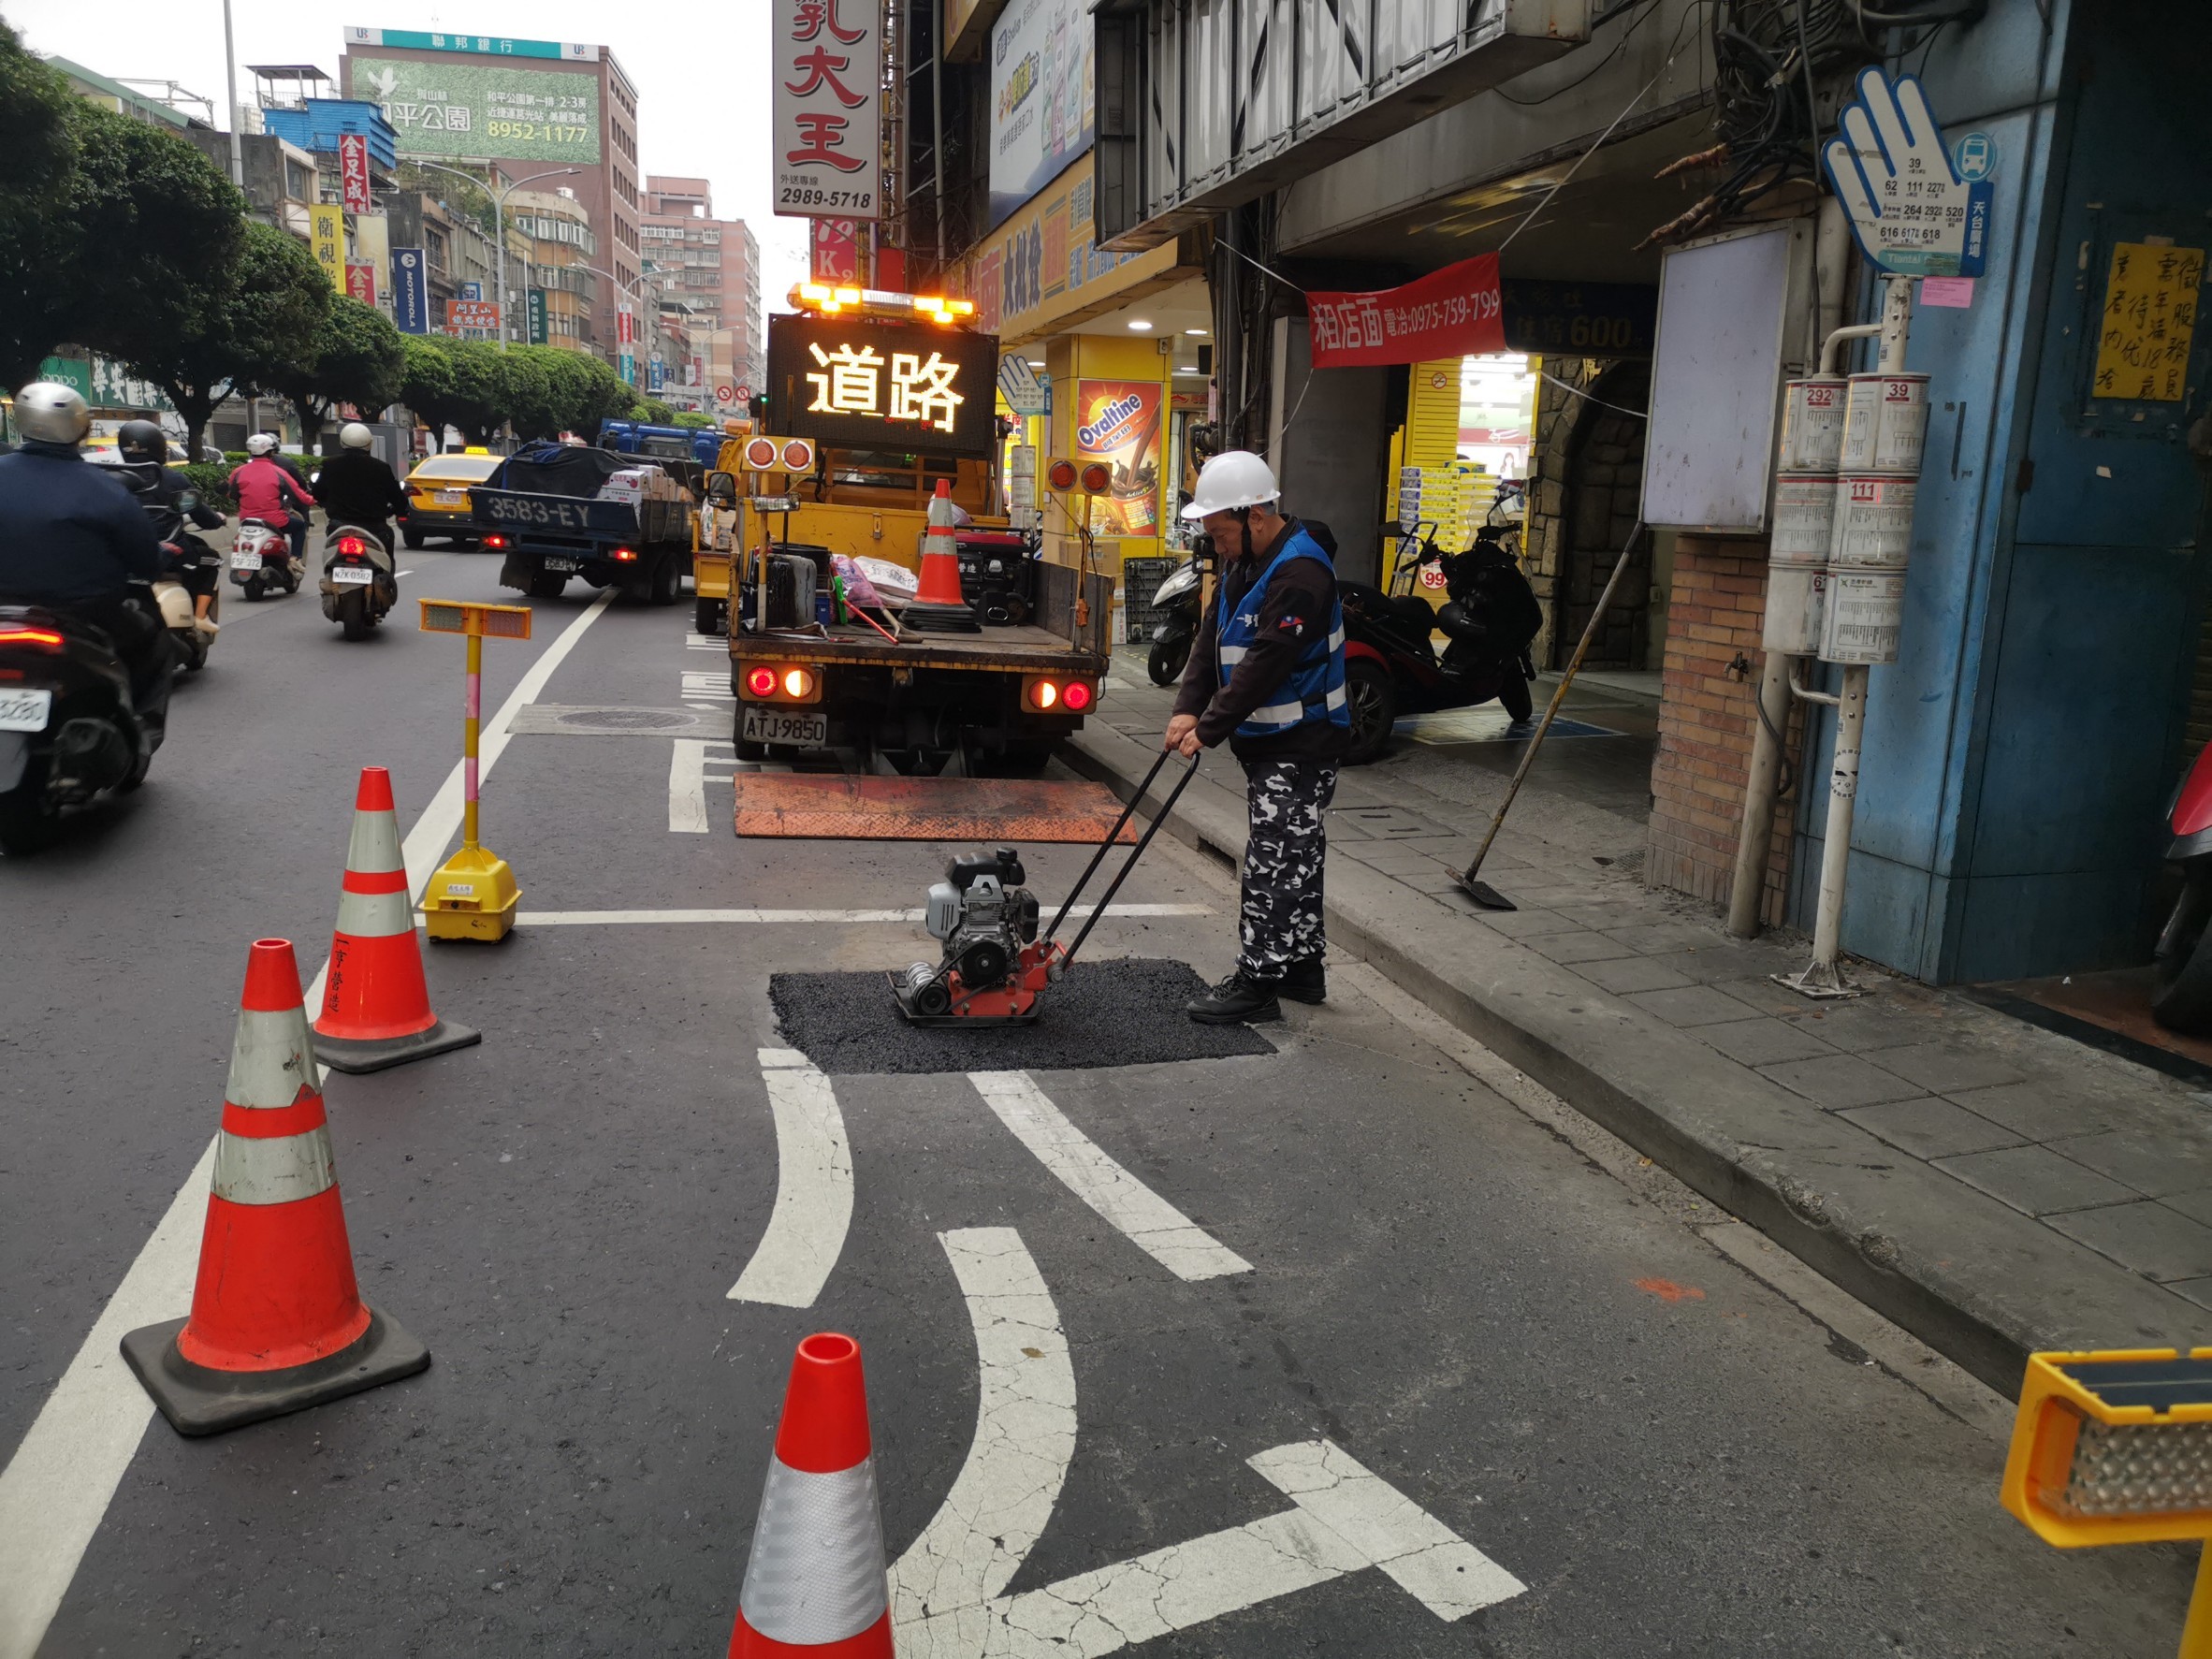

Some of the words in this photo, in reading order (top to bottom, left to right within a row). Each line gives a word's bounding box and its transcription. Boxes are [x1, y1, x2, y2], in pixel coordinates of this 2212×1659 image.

[431, 34, 513, 53] 聯邦銀行
[488, 120, 588, 143] 8952-1177
[1909, 158, 1921, 168] 39
[780, 174, 819, 186] 外送專線
[1885, 181, 1898, 191] 62
[1907, 182, 1923, 192] 111
[780, 187, 871, 209] 2989-5718
[1904, 205, 1922, 215] 264
[1945, 207, 1964, 217] 520
[1880, 226, 1899, 238] 616
[1922, 229, 1941, 240] 618
[405, 270, 416, 328] MOTOROLA
[456, 303, 492, 315] 阿里山
[1313, 296, 1384, 352] 租店面
[807, 342, 965, 433] 道路
[1807, 389, 1832, 401] 292
[1889, 384, 1908, 397] 39
[1078, 393, 1142, 446] Ovaltine
[1102, 424, 1132, 450] 阿華田
[1851, 484, 1874, 496] 111
[488, 497, 590, 528] 3583-EY
[1425, 572, 1446, 586] 99
[746, 717, 825, 742] ATJ-9850
